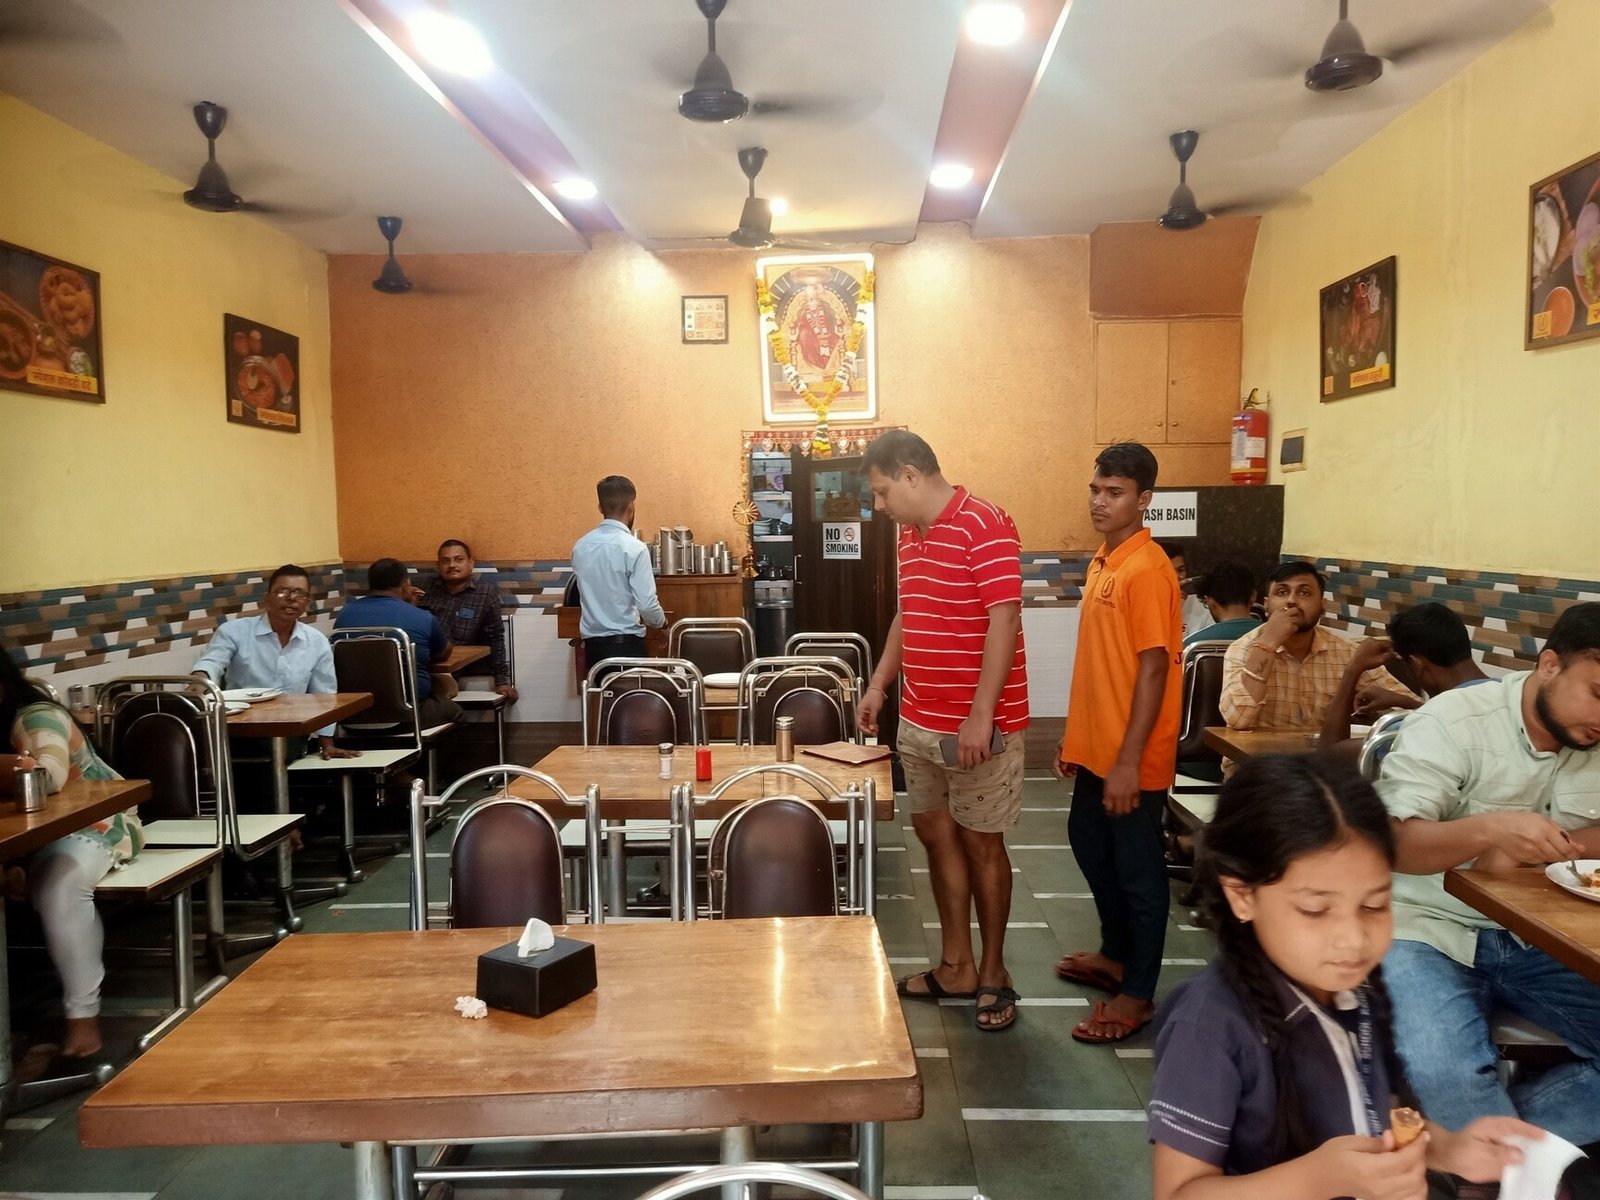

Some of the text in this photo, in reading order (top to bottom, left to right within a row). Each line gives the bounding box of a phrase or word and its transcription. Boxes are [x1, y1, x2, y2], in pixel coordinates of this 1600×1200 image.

[1144, 508, 1196, 521] ASH BASIN
[825, 528, 840, 540] NO
[825, 543, 859, 553] SMOKING
